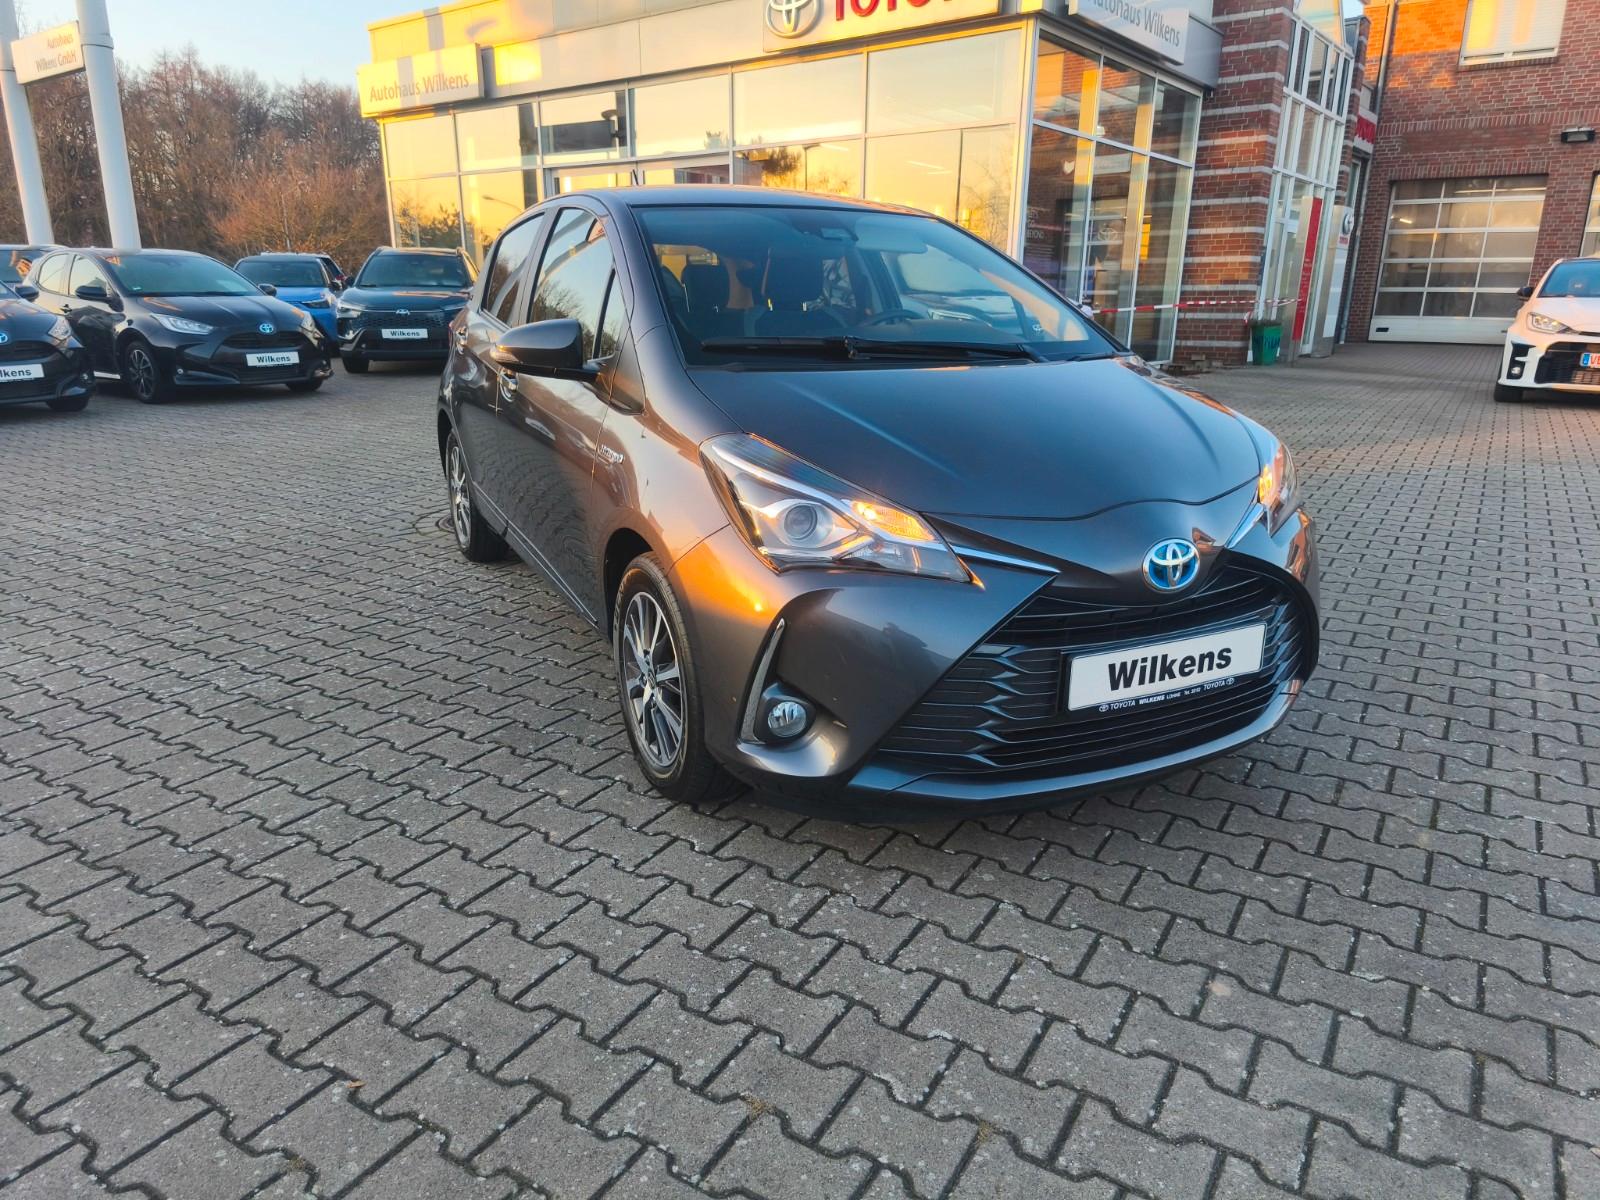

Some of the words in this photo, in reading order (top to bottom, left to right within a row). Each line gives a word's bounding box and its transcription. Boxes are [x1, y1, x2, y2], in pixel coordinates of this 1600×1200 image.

[1144, 8, 1180, 47] Wilkens
[57, 50, 77, 66] GmbH
[370, 81, 421, 102] Autohaus
[422, 73, 469, 94] Wilkens
[256, 355, 291, 363] Wilkens
[1108, 647, 1232, 691] Wilkens
[1110, 699, 1136, 710] TOYOTA
[1139, 694, 1166, 705] WILKENS
[1204, 680, 1226, 690] TOYOTA
